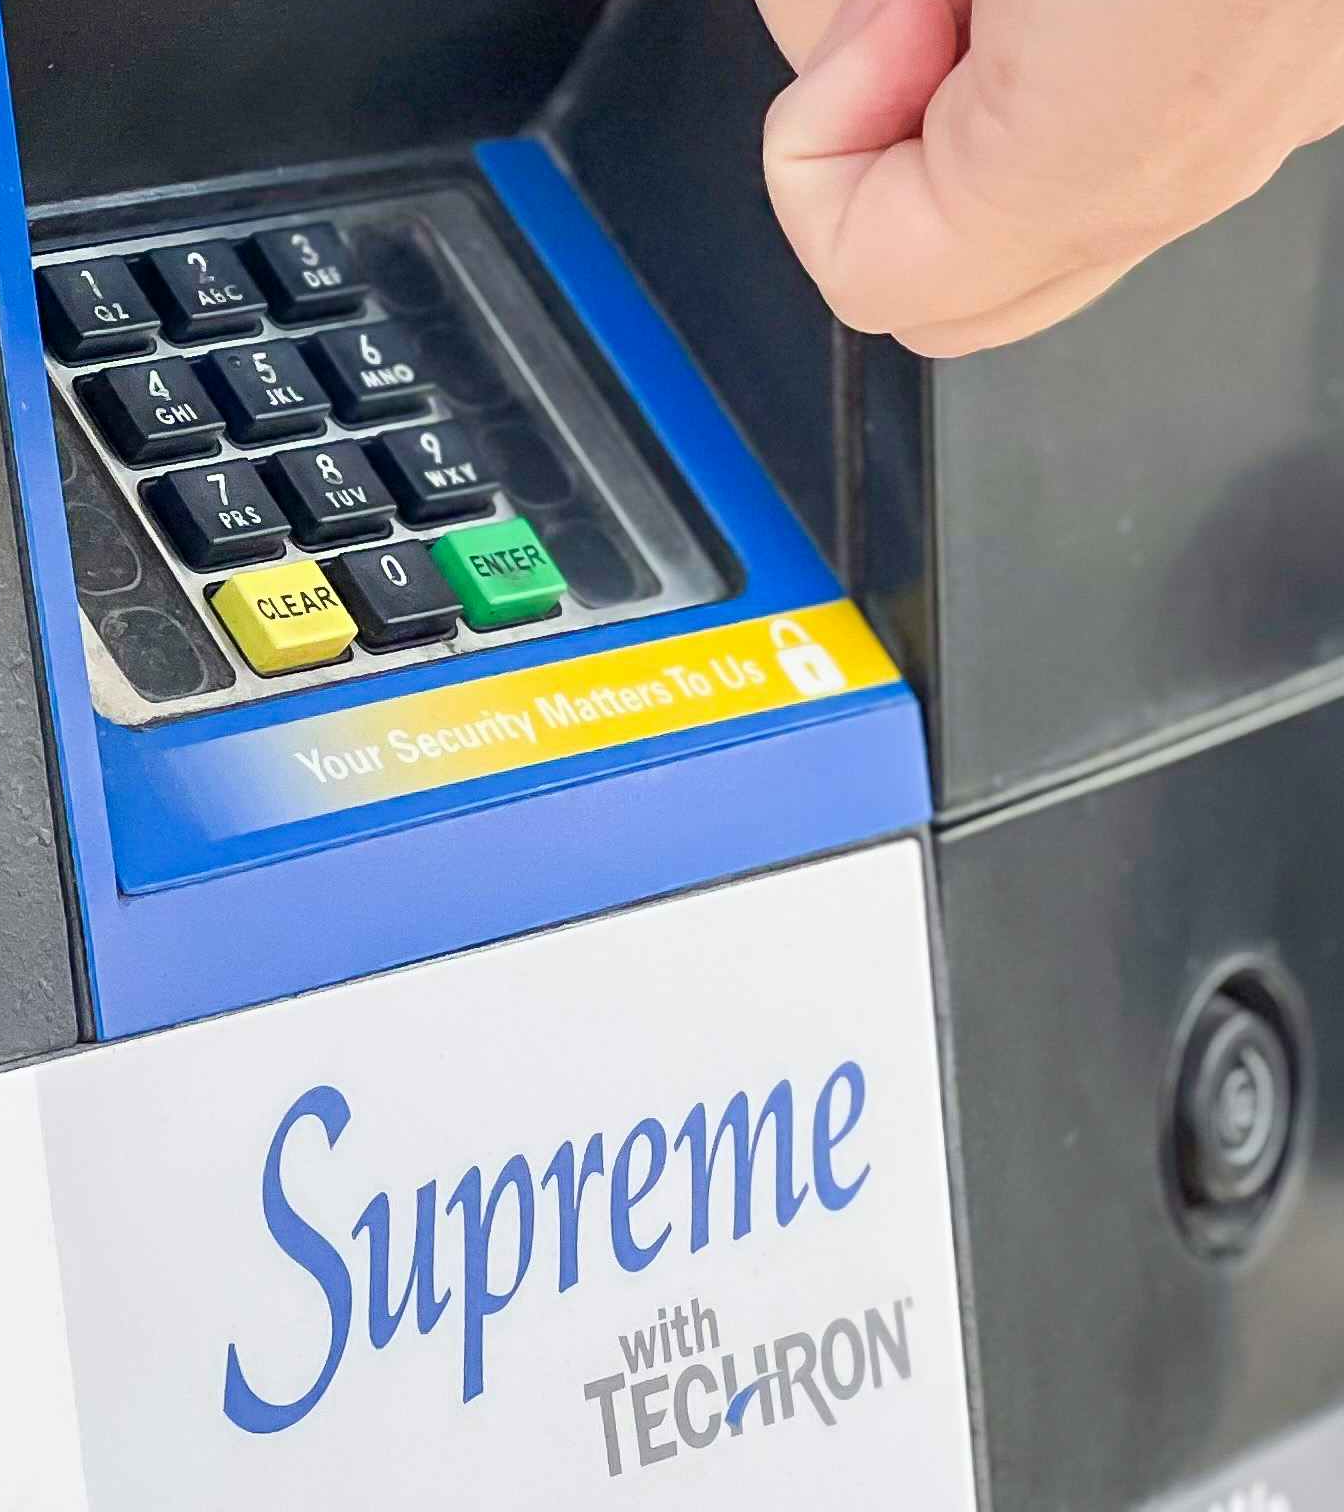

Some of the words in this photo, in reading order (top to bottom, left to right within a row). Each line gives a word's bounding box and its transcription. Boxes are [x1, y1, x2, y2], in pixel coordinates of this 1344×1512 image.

[291, 233, 320, 266] 3
[187, 251, 215, 284] 2
[302, 265, 342, 288] DEF
[81, 270, 103, 300] 1
[197, 284, 244, 307] ABC
[360, 333, 382, 365] 6
[252, 352, 277, 385] 5
[360, 362, 416, 389] MNO
[148, 369, 171, 402] 4
[268, 385, 305, 407] JKL
[155, 403, 199, 426] GHI
[420, 432, 443, 465] 9
[315, 452, 343, 486] 8
[424, 461, 479, 489] WXY
[206, 472, 230, 506] 7
[324, 486, 368, 510] TUV
[218, 506, 263, 531] PRS
[380, 554, 408, 588] 0
[468, 544, 547, 579] ENTER
[256, 585, 339, 621] CLEAR
[295, 742, 385, 786] Your
[387, 711, 537, 765] Security
[536, 689, 672, 732] Matters
[665, 664, 712, 701] To
[716, 653, 767, 692] Us
[223, 1060, 873, 1436] Supreme
[619, 1297, 722, 1371] with
